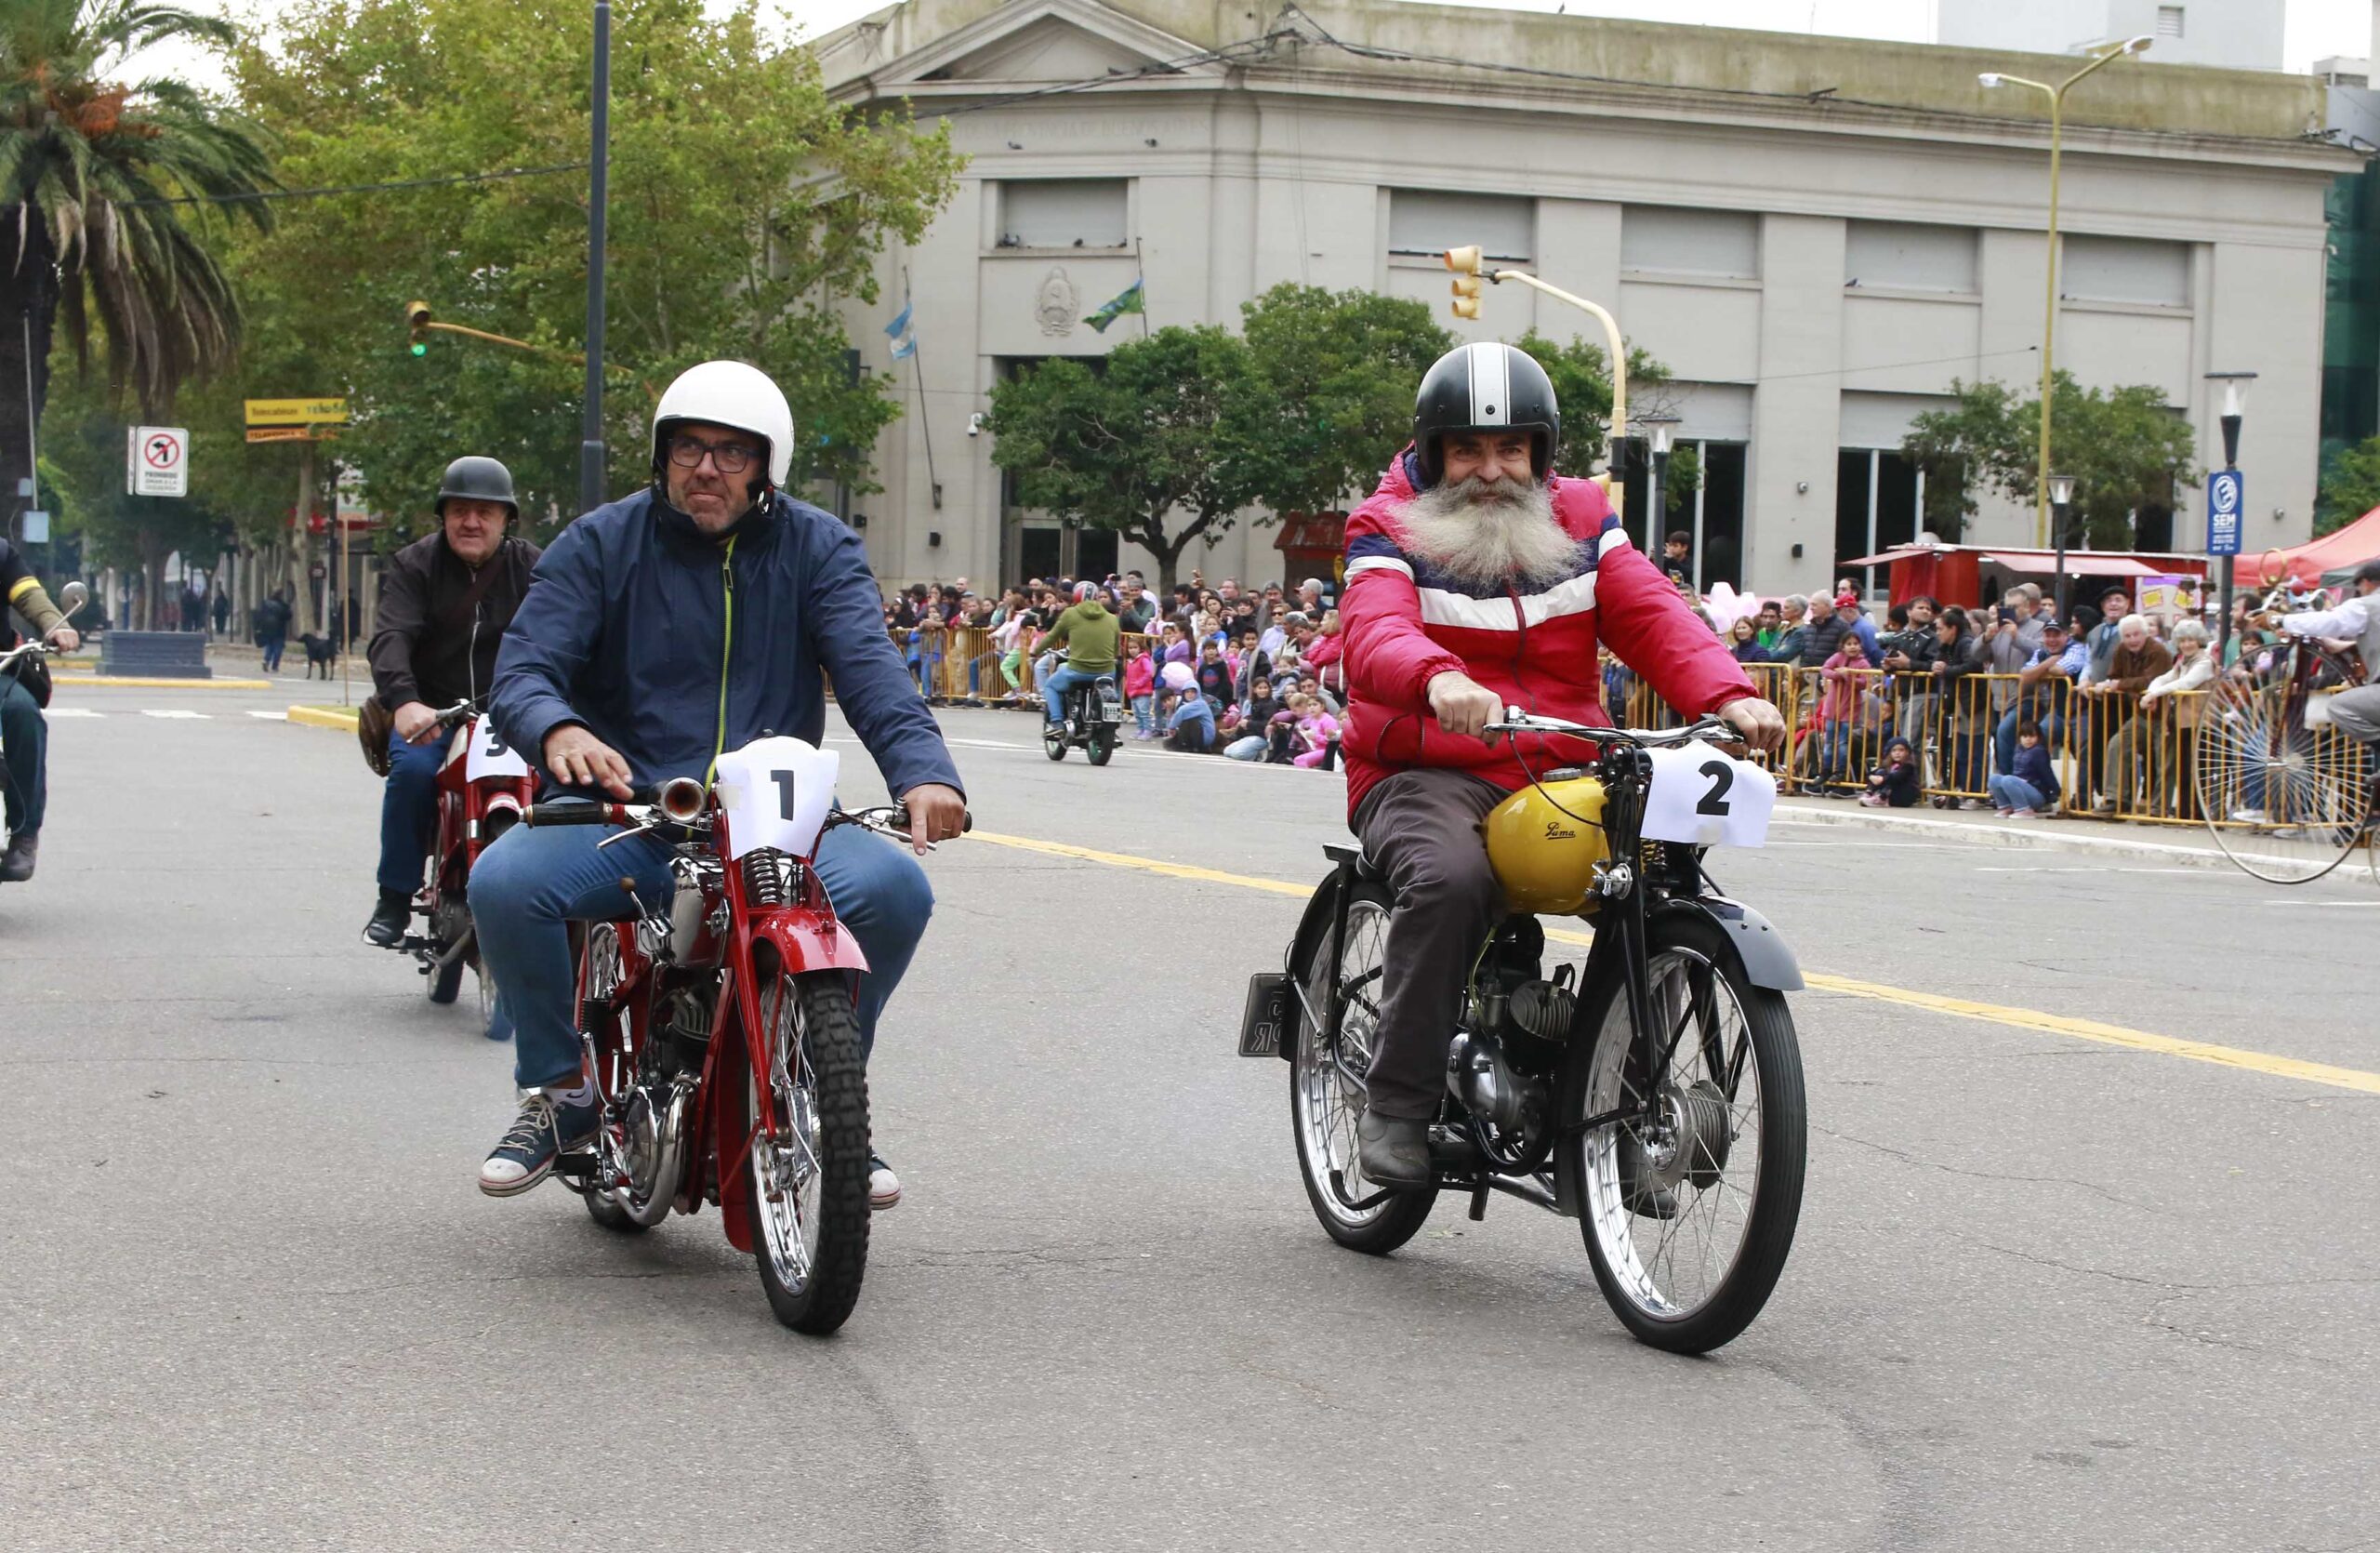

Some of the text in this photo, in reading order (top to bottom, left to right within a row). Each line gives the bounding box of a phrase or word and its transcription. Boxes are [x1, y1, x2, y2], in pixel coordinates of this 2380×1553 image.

[2213, 513, 2237, 526] SEM
[770, 769, 795, 822] 1
[1696, 760, 1734, 816] 2
[1544, 821, 1577, 840] Puma
